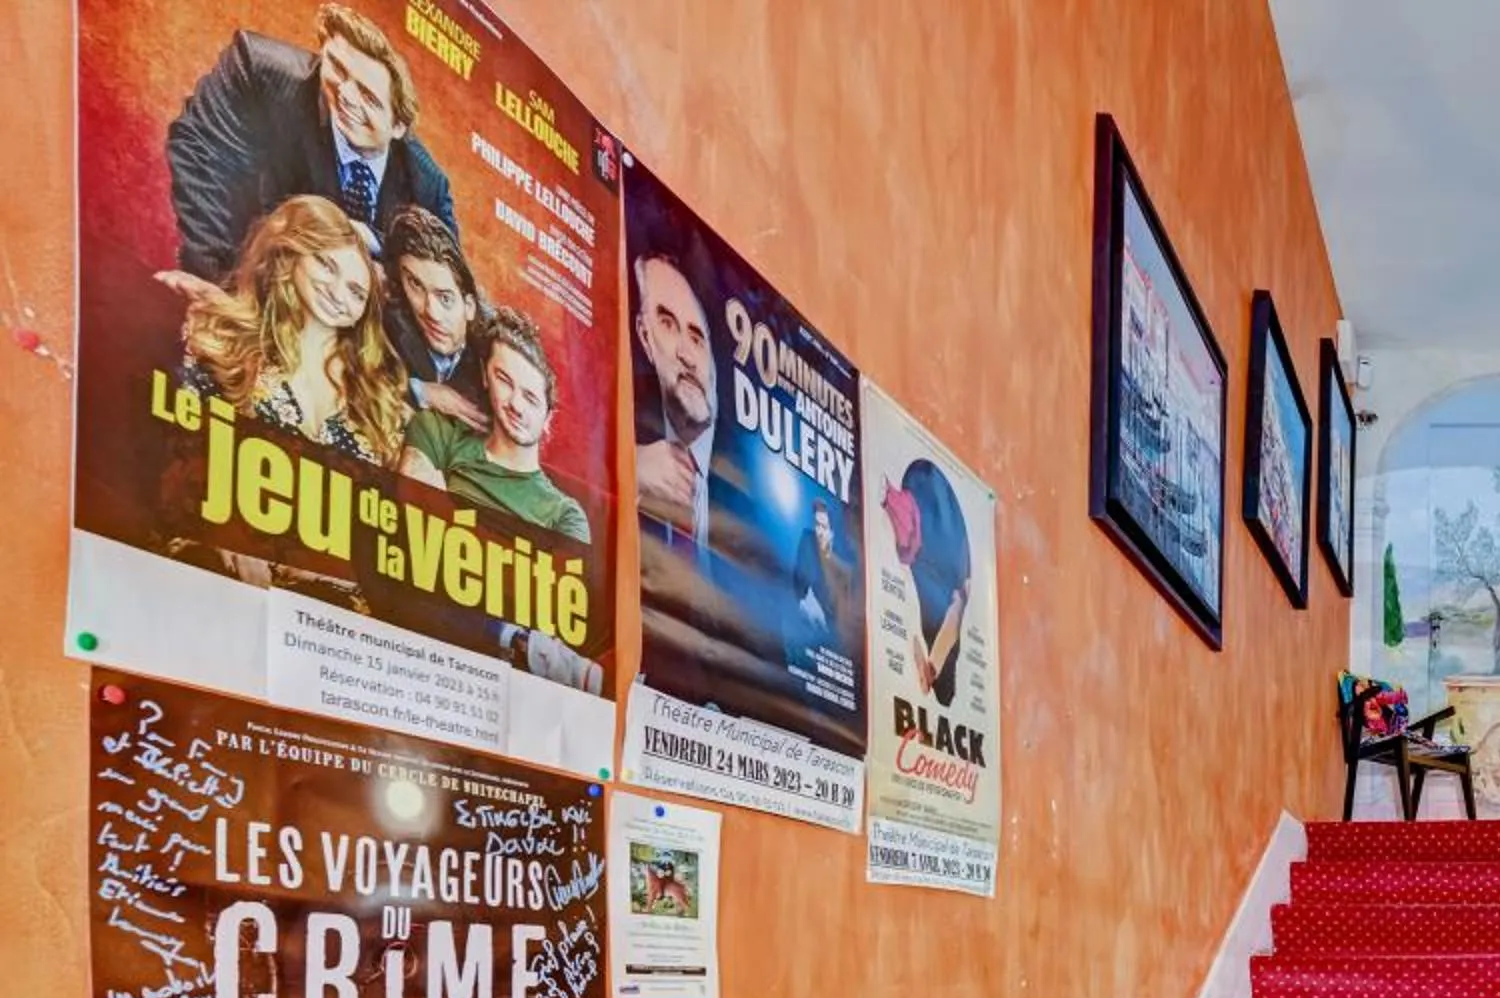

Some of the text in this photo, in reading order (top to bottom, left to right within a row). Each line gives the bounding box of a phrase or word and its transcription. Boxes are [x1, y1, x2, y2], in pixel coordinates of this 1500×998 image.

[405, 4, 474, 81] BIERRY
[496, 81, 579, 176] LELLOUCHE
[528, 89, 556, 124] SAM
[471, 130, 534, 197] PHILIPPE
[152, 369, 201, 432] Le
[726, 297, 779, 388] 90
[778, 340, 854, 430] MINUTES
[734, 366, 855, 503] DULERY
[795, 390, 855, 458] ANTOINE
[202, 395, 353, 561] jeu
[360, 487, 398, 536] de
[377, 533, 405, 581] la
[405, 504, 589, 648] vérité
[284, 631, 363, 665] Dimanche
[366, 654, 384, 672] 15
[386, 659, 431, 684] janvier
[434, 672, 464, 694] 2023
[295, 609, 500, 683] Théâtre municipal de Tarascon
[319, 664, 406, 700] Réservation
[414, 688, 432, 706] 04
[216, 728, 253, 752] PAR
[259, 738, 345, 769] L'ÉQUIPE
[350, 757, 373, 775] DU
[377, 763, 437, 787] CERCLE
[441, 776, 460, 792] DE
[643, 725, 712, 771] VENDREDI
[717, 750, 734, 775] 24
[737, 755, 770, 783] MARS
[773, 762, 801, 791] 2023
[815, 777, 829, 797] 20
[831, 782, 839, 802] H
[652, 693, 855, 778] Théâtre Municipal de Tarascon
[894, 695, 987, 769] BLACK
[895, 727, 980, 805] Comedy
[215, 817, 304, 889] LES
[320, 831, 545, 911] VOYAGEURS
[382, 905, 411, 940] DU
